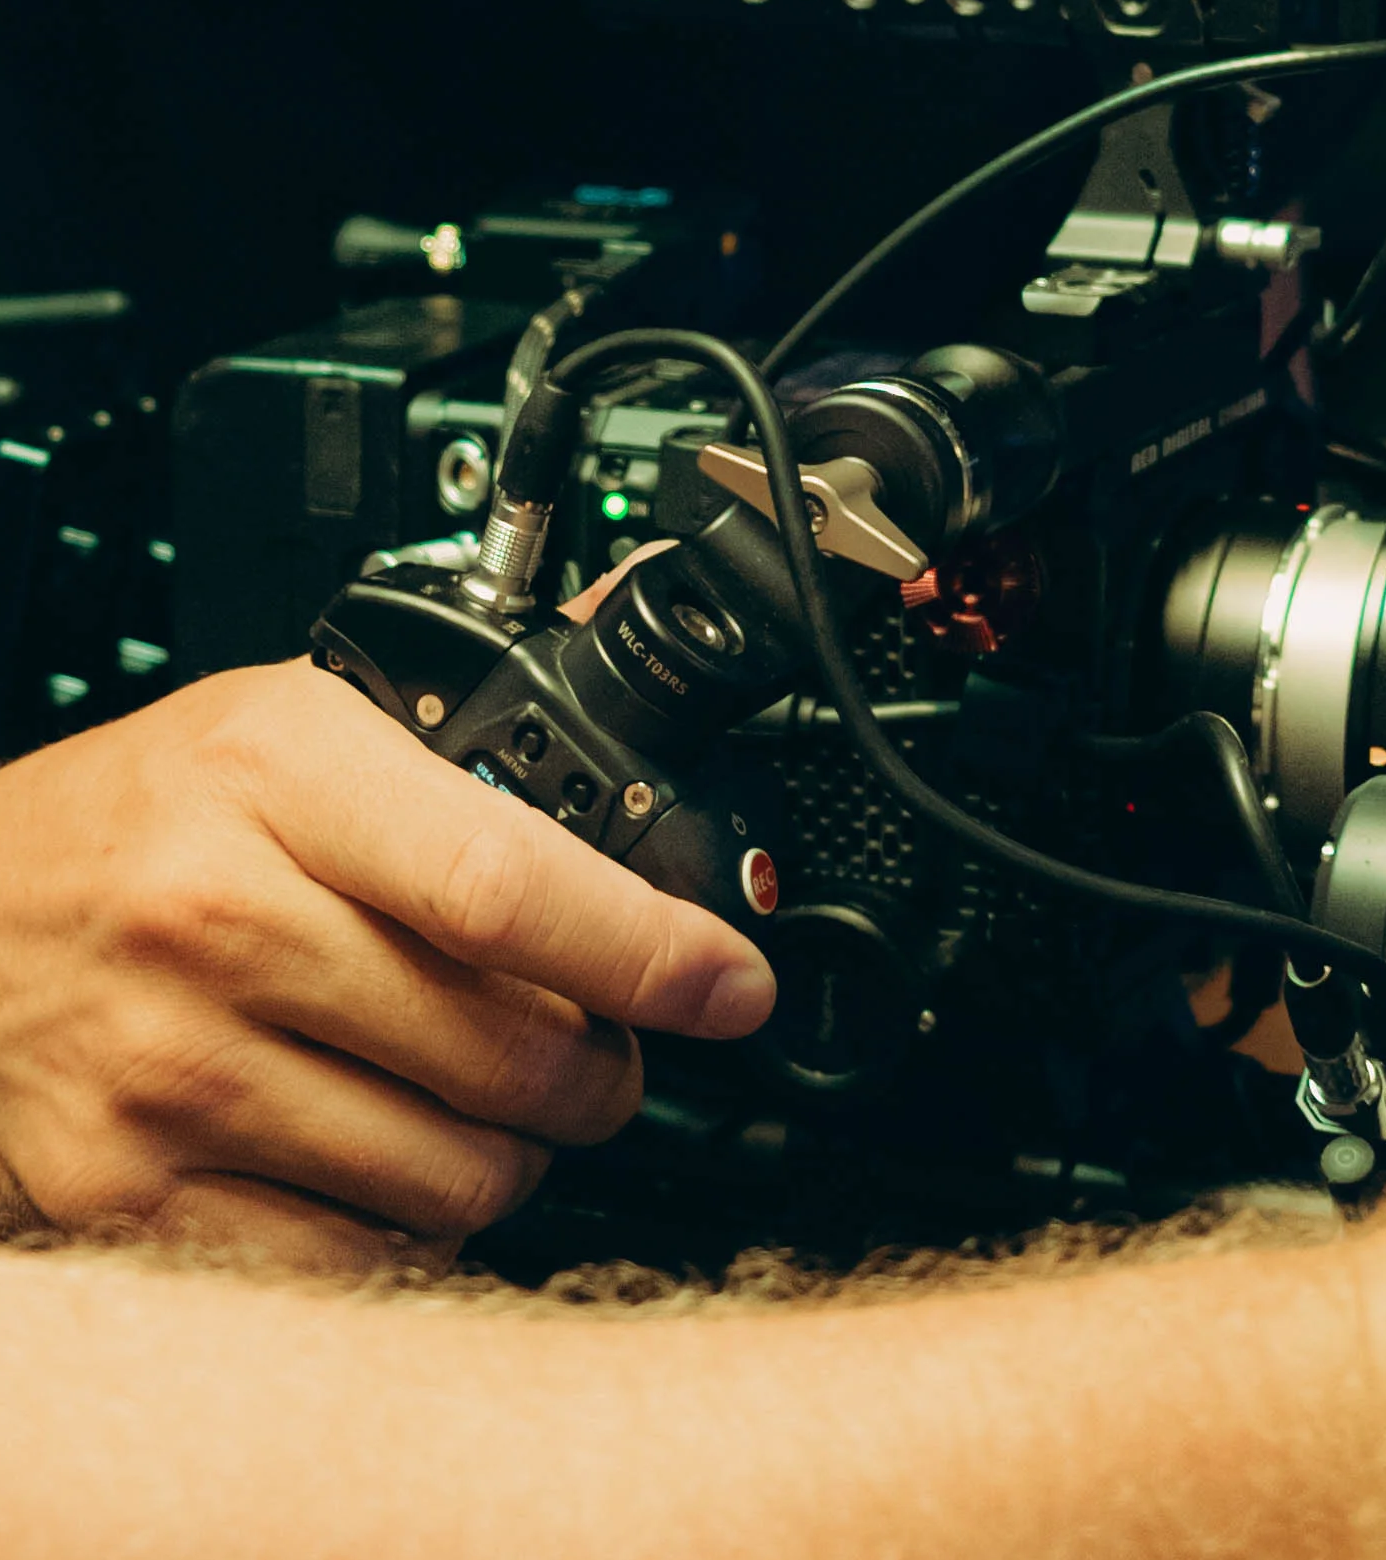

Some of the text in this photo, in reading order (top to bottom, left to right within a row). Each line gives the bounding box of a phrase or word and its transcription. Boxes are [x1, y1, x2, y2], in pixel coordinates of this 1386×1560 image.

[616, 619, 690, 697] WLC-T03RS
[496, 747, 530, 781] MENU
[752, 866, 776, 896] REC
